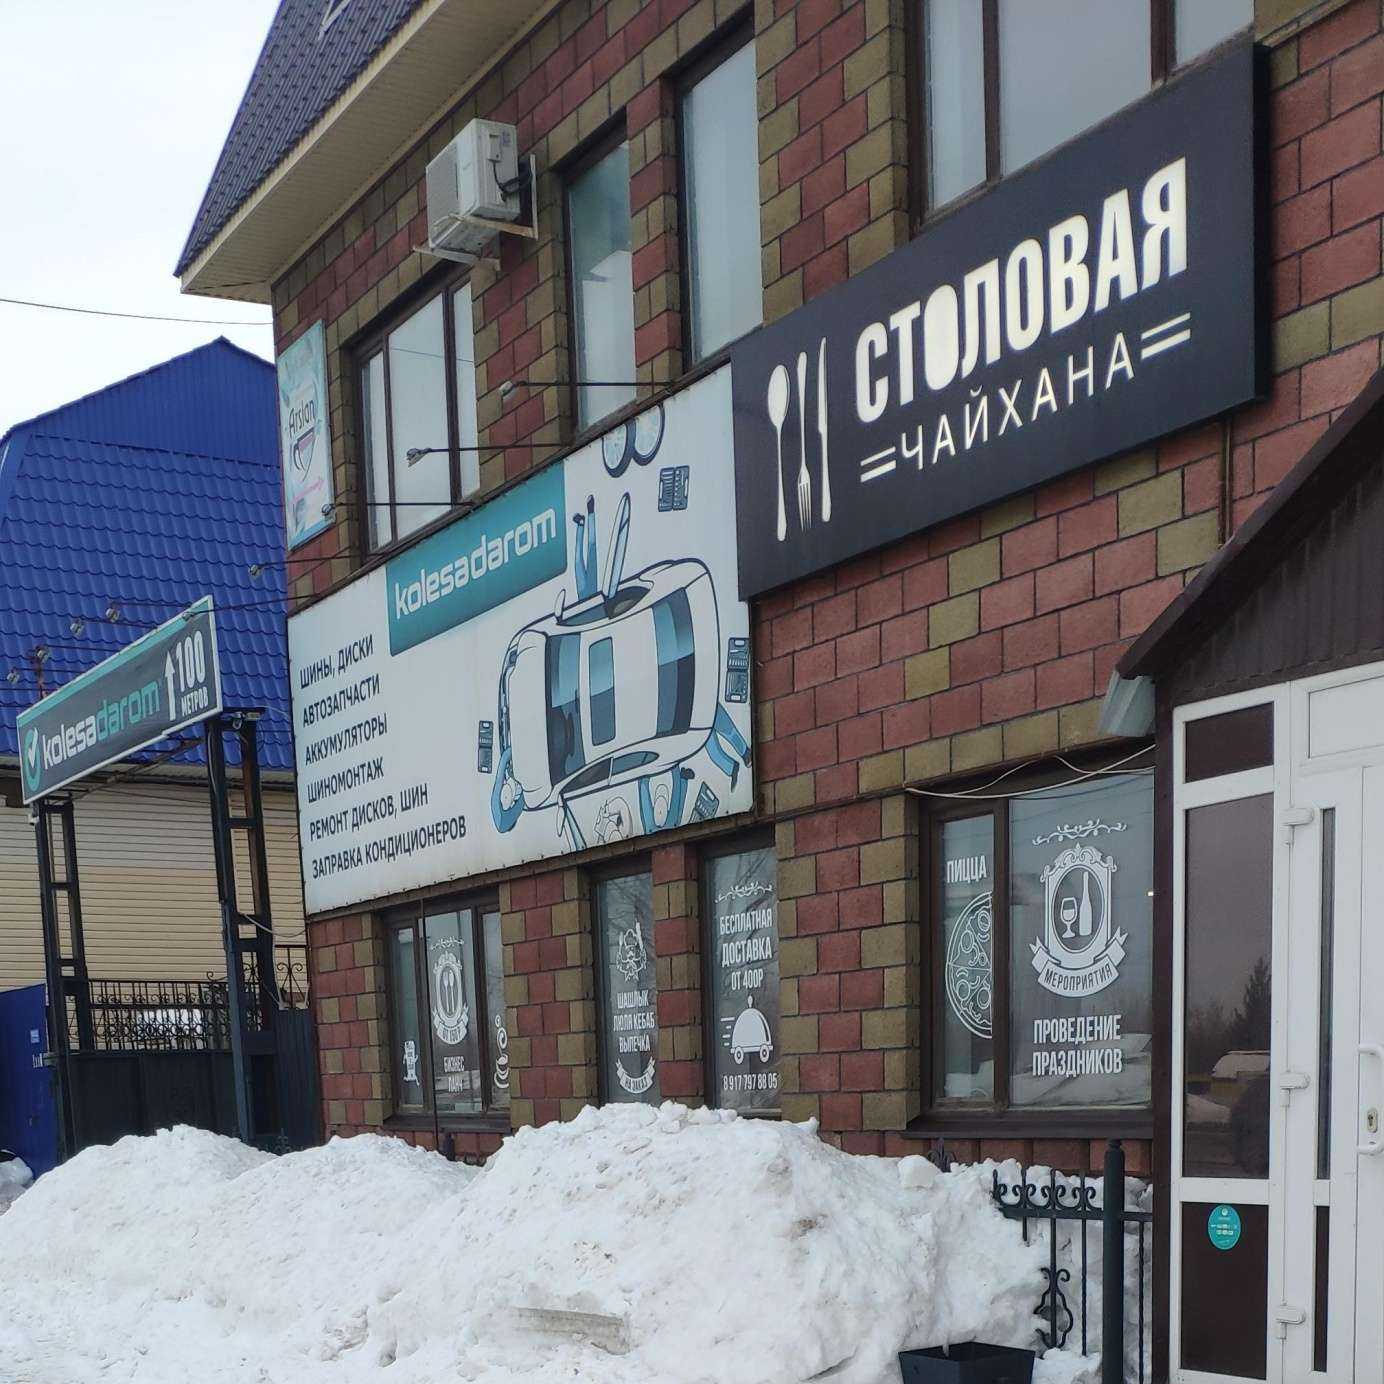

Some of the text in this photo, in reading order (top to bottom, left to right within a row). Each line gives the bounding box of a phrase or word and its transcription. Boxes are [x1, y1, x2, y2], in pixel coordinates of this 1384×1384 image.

[856, 155, 1188, 424] СТОЛОВАЯ
[900, 331, 1136, 471] ЧАЙХАНА
[395, 508, 557, 620] kolesadarom
[176, 630, 206, 692] 100
[299, 634, 375, 690] ШИНЫ, ДИСКИ
[181, 686, 209, 717] МЕТРОВ
[302, 673, 381, 728] АВТОЗАПЧАСТИ
[43, 680, 160, 770] kolesadarom
[305, 712, 388, 766] АККУМУЛЯТОРЫ
[307, 756, 385, 804] ШИНОМОНТАЖ
[309, 783, 429, 842] РЕМОНТ ДИСКОВ, ШИН
[312, 815, 467, 880] ЗАПРАВКА КОНДИЦИОНЕРОВ
[946, 855, 987, 884] ПИЦЦА
[720, 908, 773, 935] БЕСПЛАТНАЯ
[721, 936, 772, 968] ДОСТАВКА
[731, 968, 764, 990] ОТ 400Р
[1044, 963, 1113, 992] МЕРОПРИЯТИЯ
[617, 989, 649, 1009] ШАШЛЫК
[613, 1011, 655, 1032] ЛЮЛЯ КЕБАБ
[1033, 1014, 1122, 1045] ПРОВЕДЕНИЕ
[619, 1034, 651, 1053] ВЫПЕЧКА
[1032, 1048, 1123, 1078] ПРАЗДНИКОВ
[723, 1072, 778, 1090] 8 917 797 88 05
